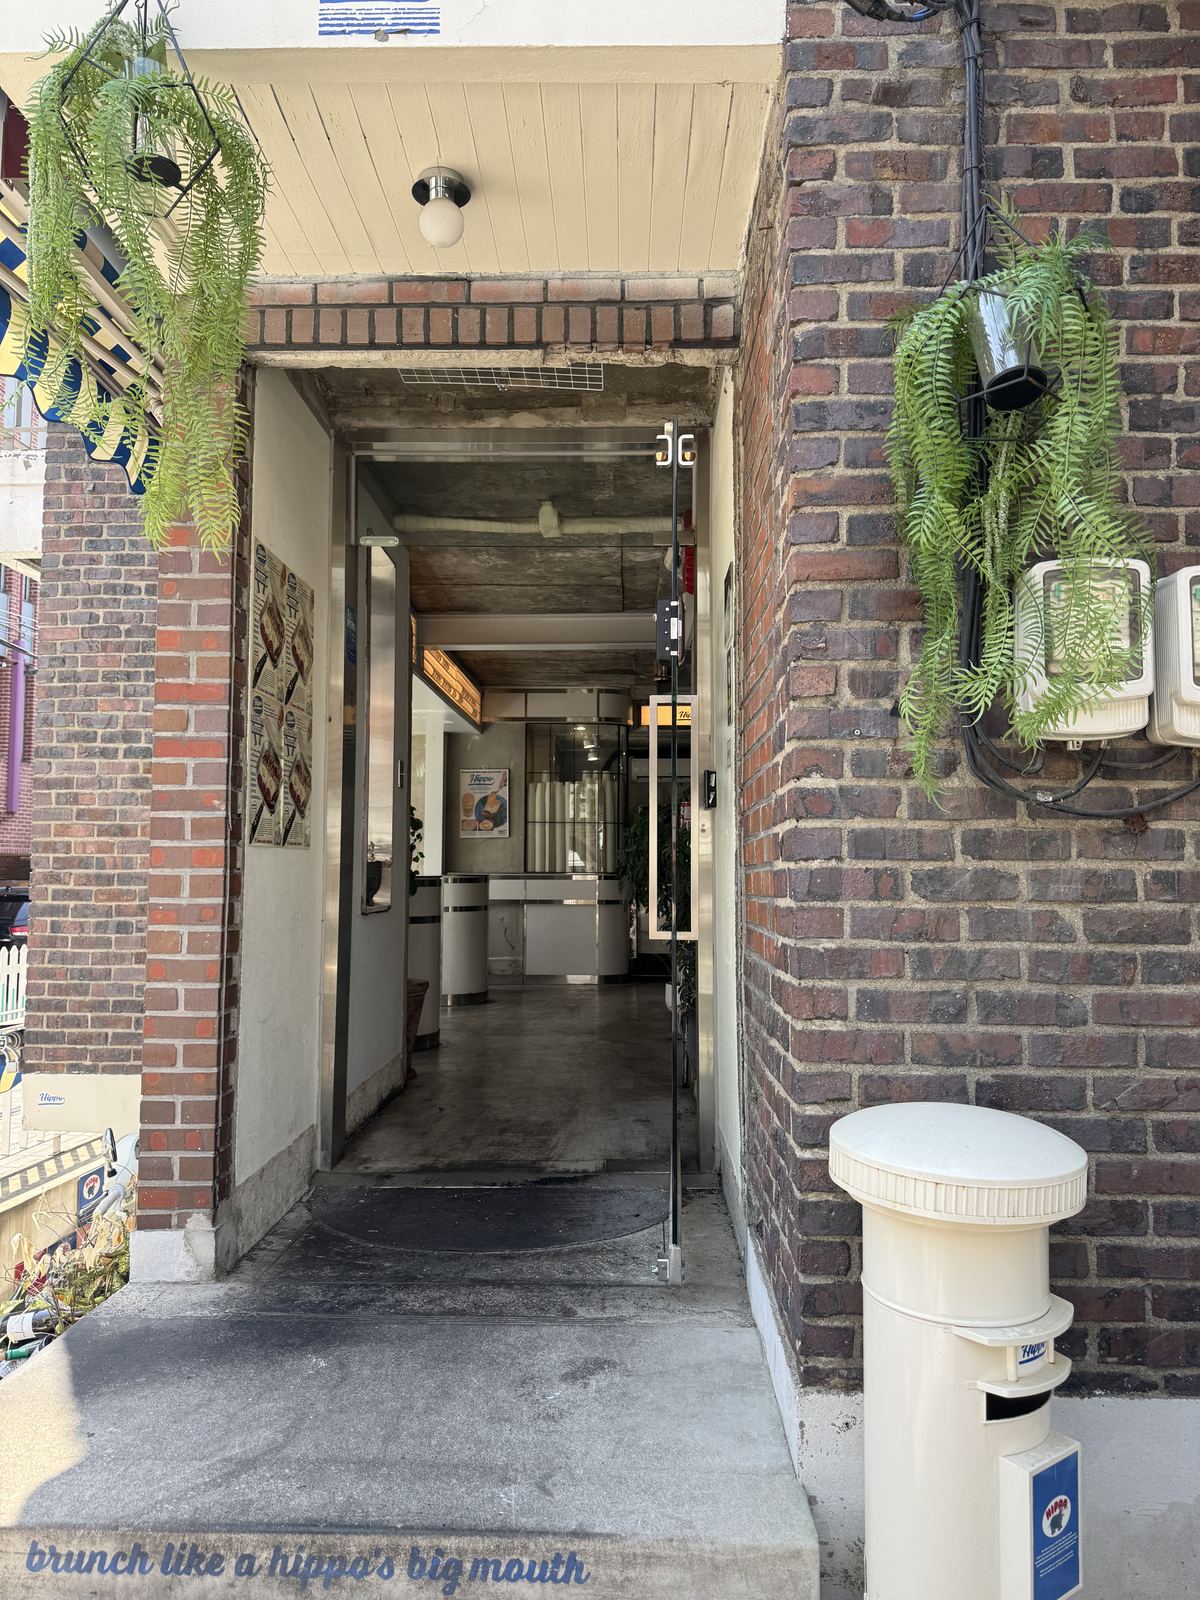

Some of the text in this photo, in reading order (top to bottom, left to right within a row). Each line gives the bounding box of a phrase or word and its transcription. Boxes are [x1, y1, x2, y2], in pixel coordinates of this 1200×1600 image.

[25, 1539, 593, 1597] brunch like a hippo's big mouth
